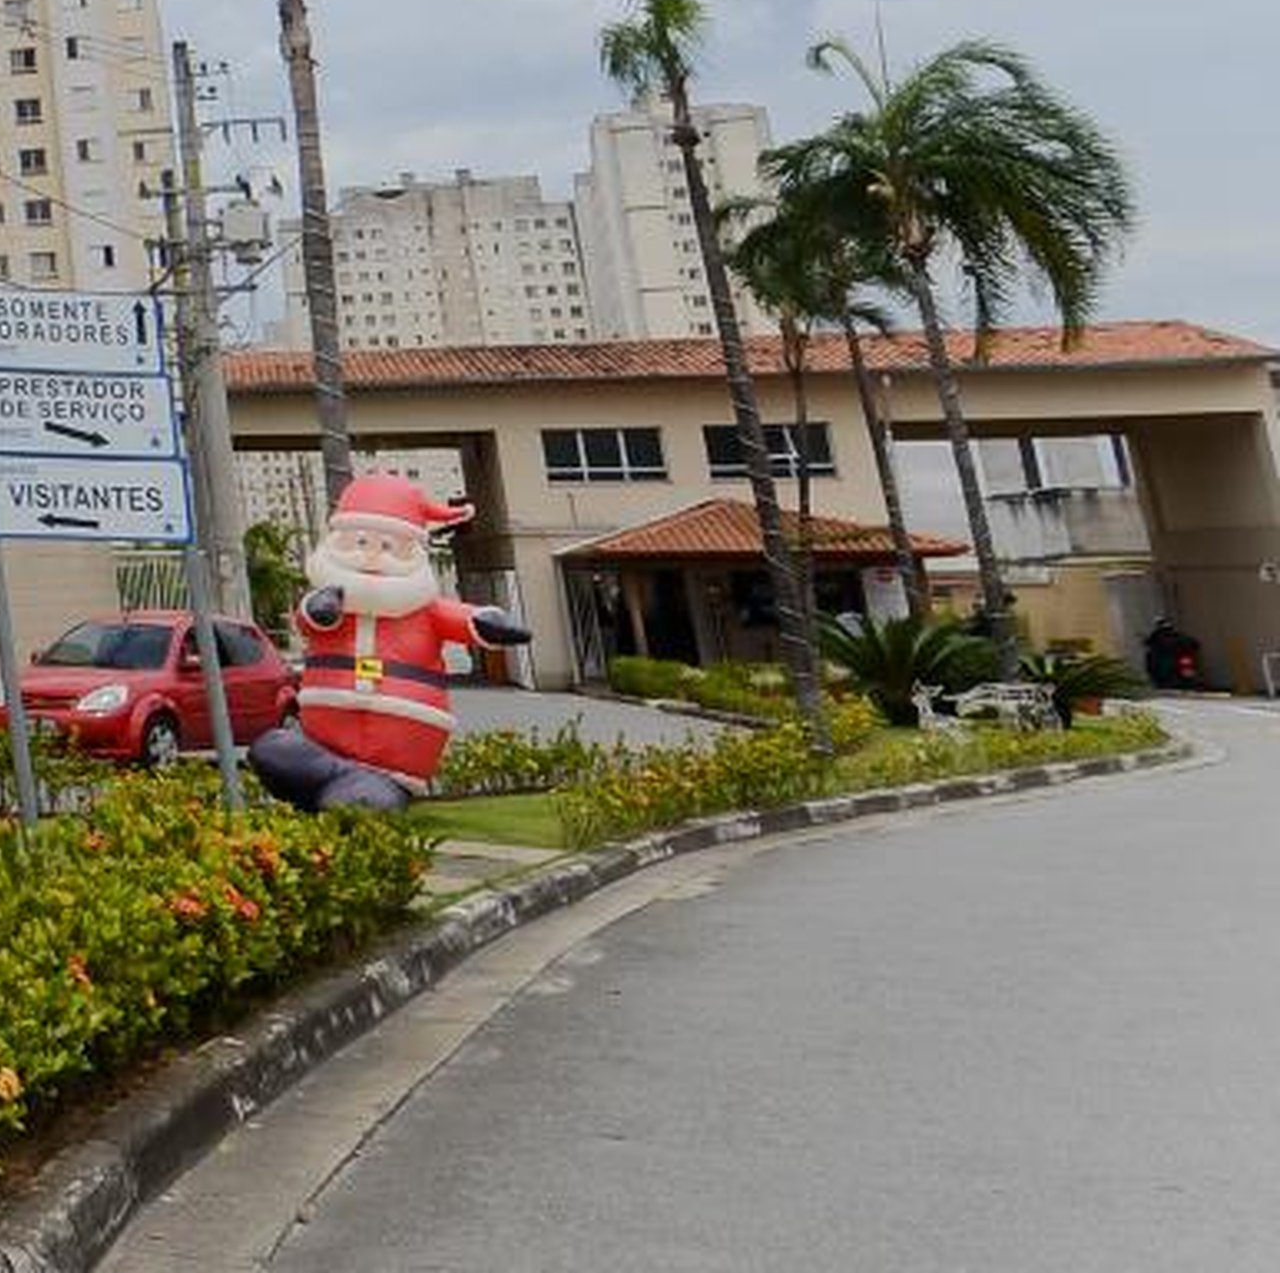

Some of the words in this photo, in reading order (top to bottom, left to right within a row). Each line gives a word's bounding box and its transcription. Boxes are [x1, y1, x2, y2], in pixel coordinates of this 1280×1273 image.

[0, 400, 30, 418] DE
[40, 401, 145, 423] SERVIÇO
[9, 484, 164, 512] VISITANTES
